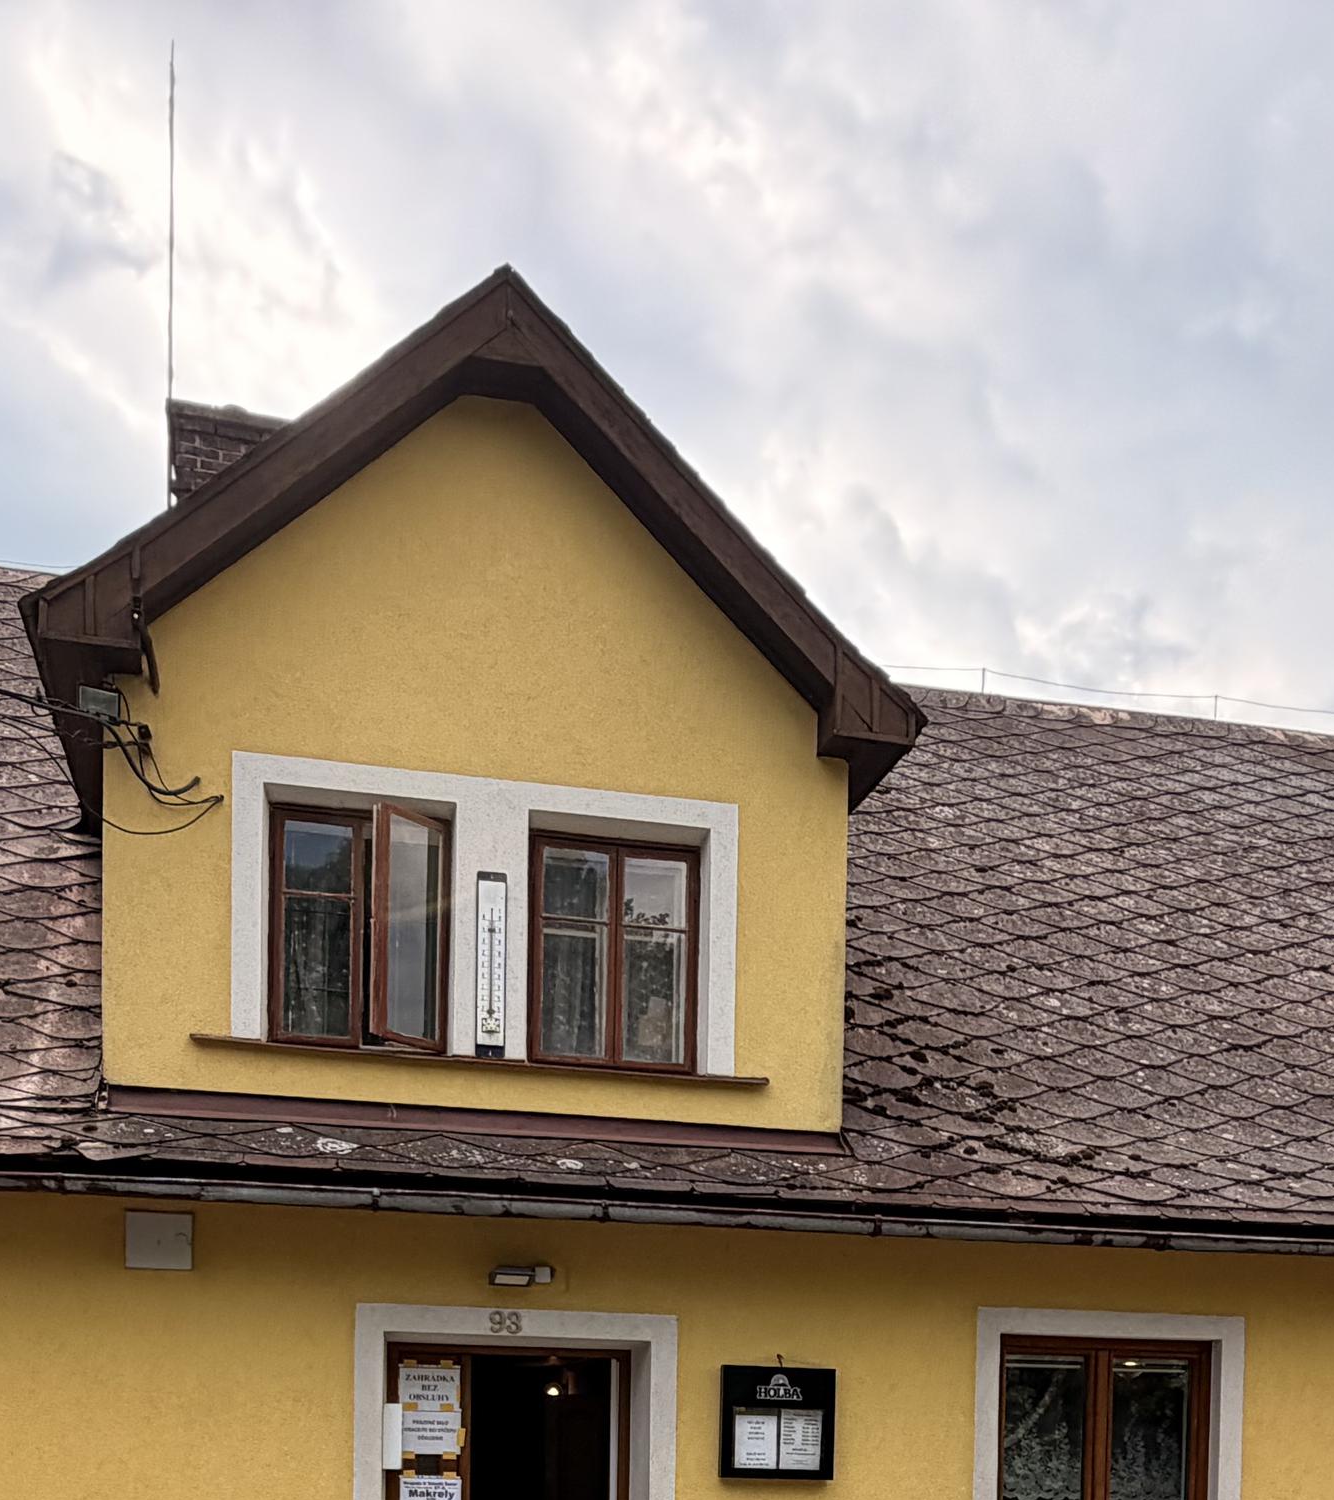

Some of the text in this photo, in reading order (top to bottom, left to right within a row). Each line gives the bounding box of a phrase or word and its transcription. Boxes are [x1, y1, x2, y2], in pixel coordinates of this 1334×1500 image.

[489, 1310, 523, 1334] 93
[756, 1385, 802, 1401] HOLBA
[408, 1489, 455, 1500] Makrely
